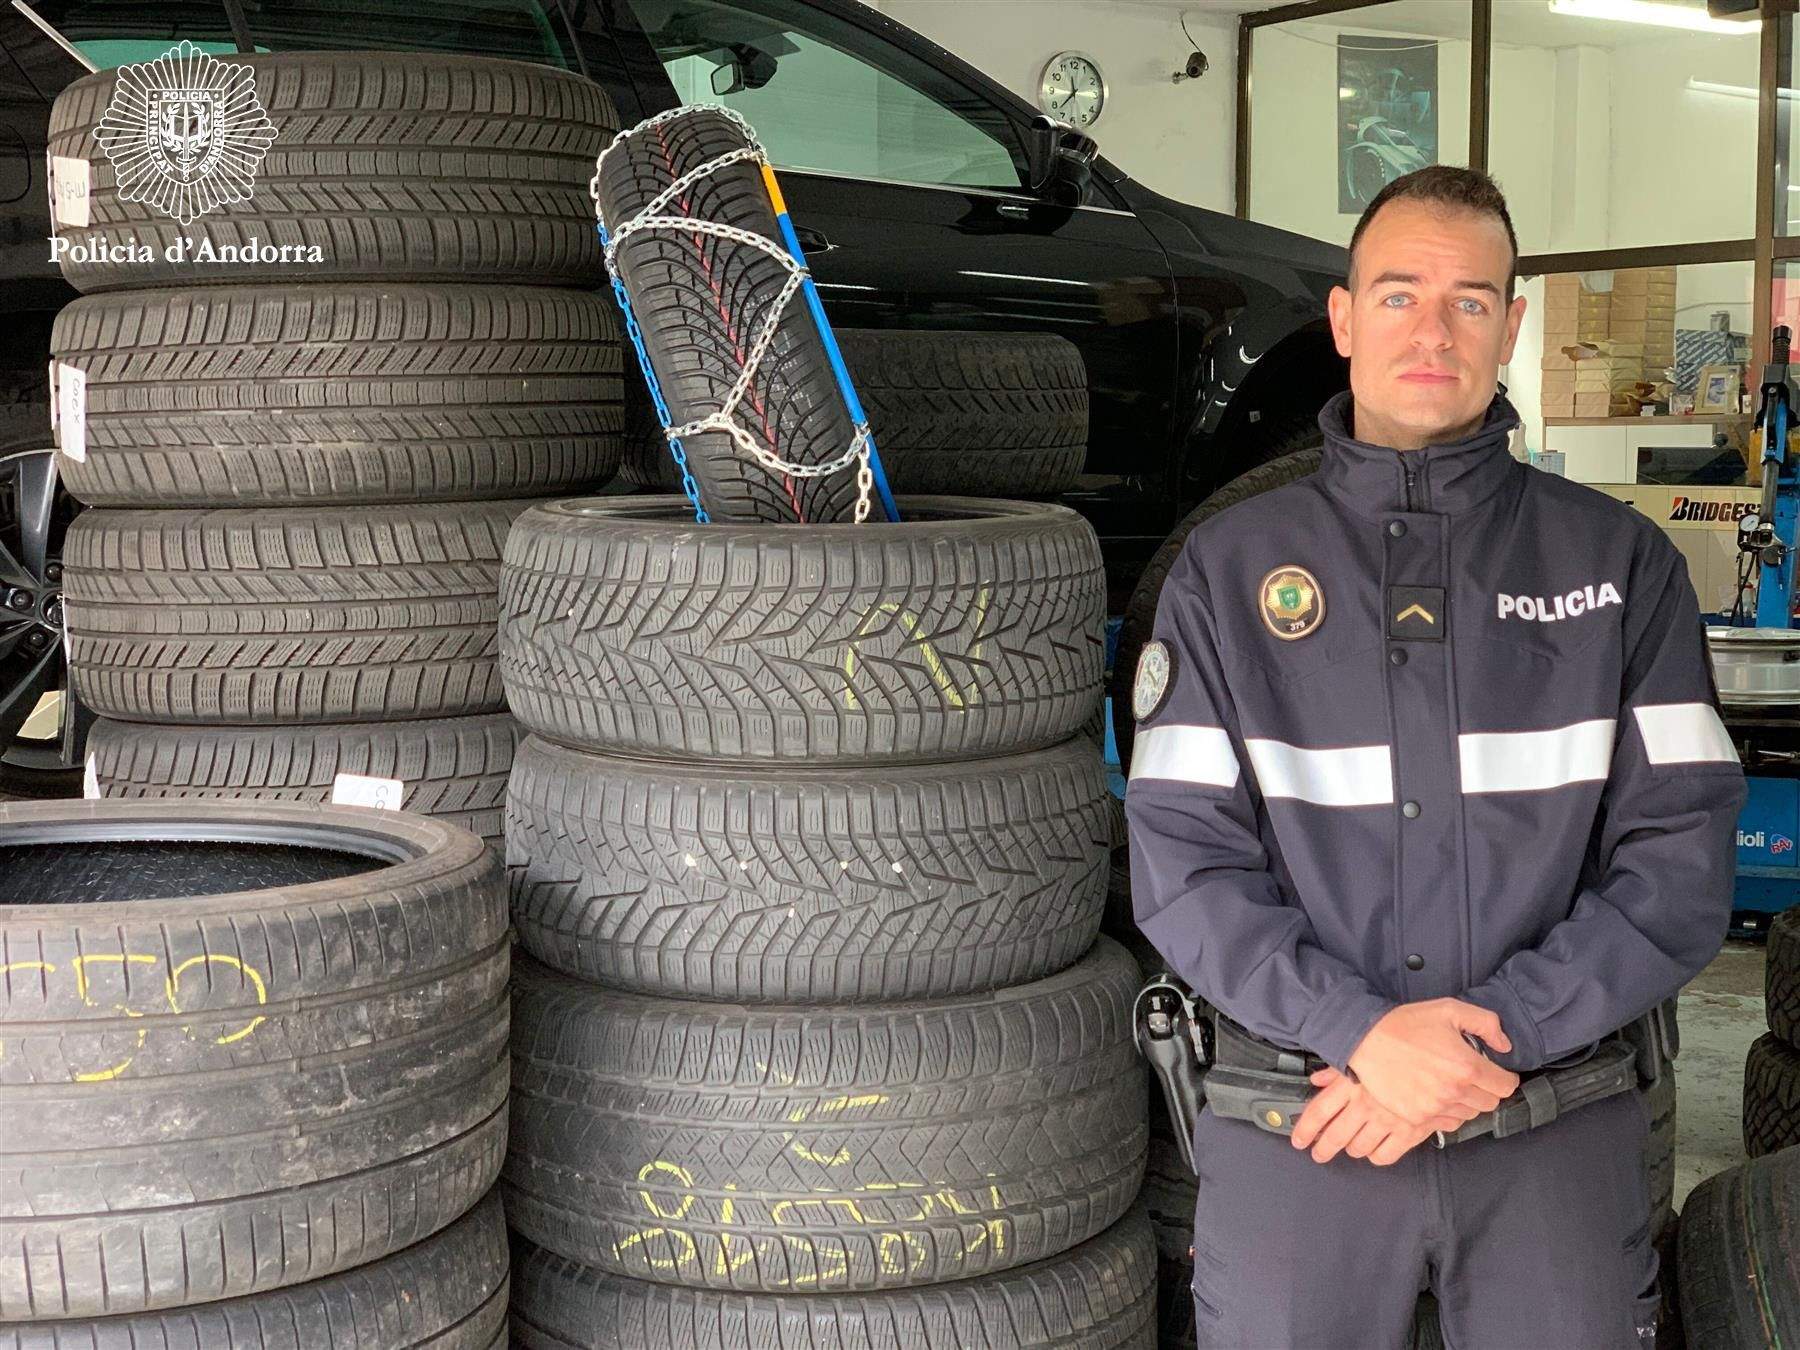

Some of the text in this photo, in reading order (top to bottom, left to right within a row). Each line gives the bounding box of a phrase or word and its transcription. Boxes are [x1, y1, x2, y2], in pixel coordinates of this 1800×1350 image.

[1070, 61, 1079, 70] 12
[1052, 72, 1061, 81] 10
[1497, 582, 1623, 622] POLICIA
[1736, 830, 1765, 847] lioli
